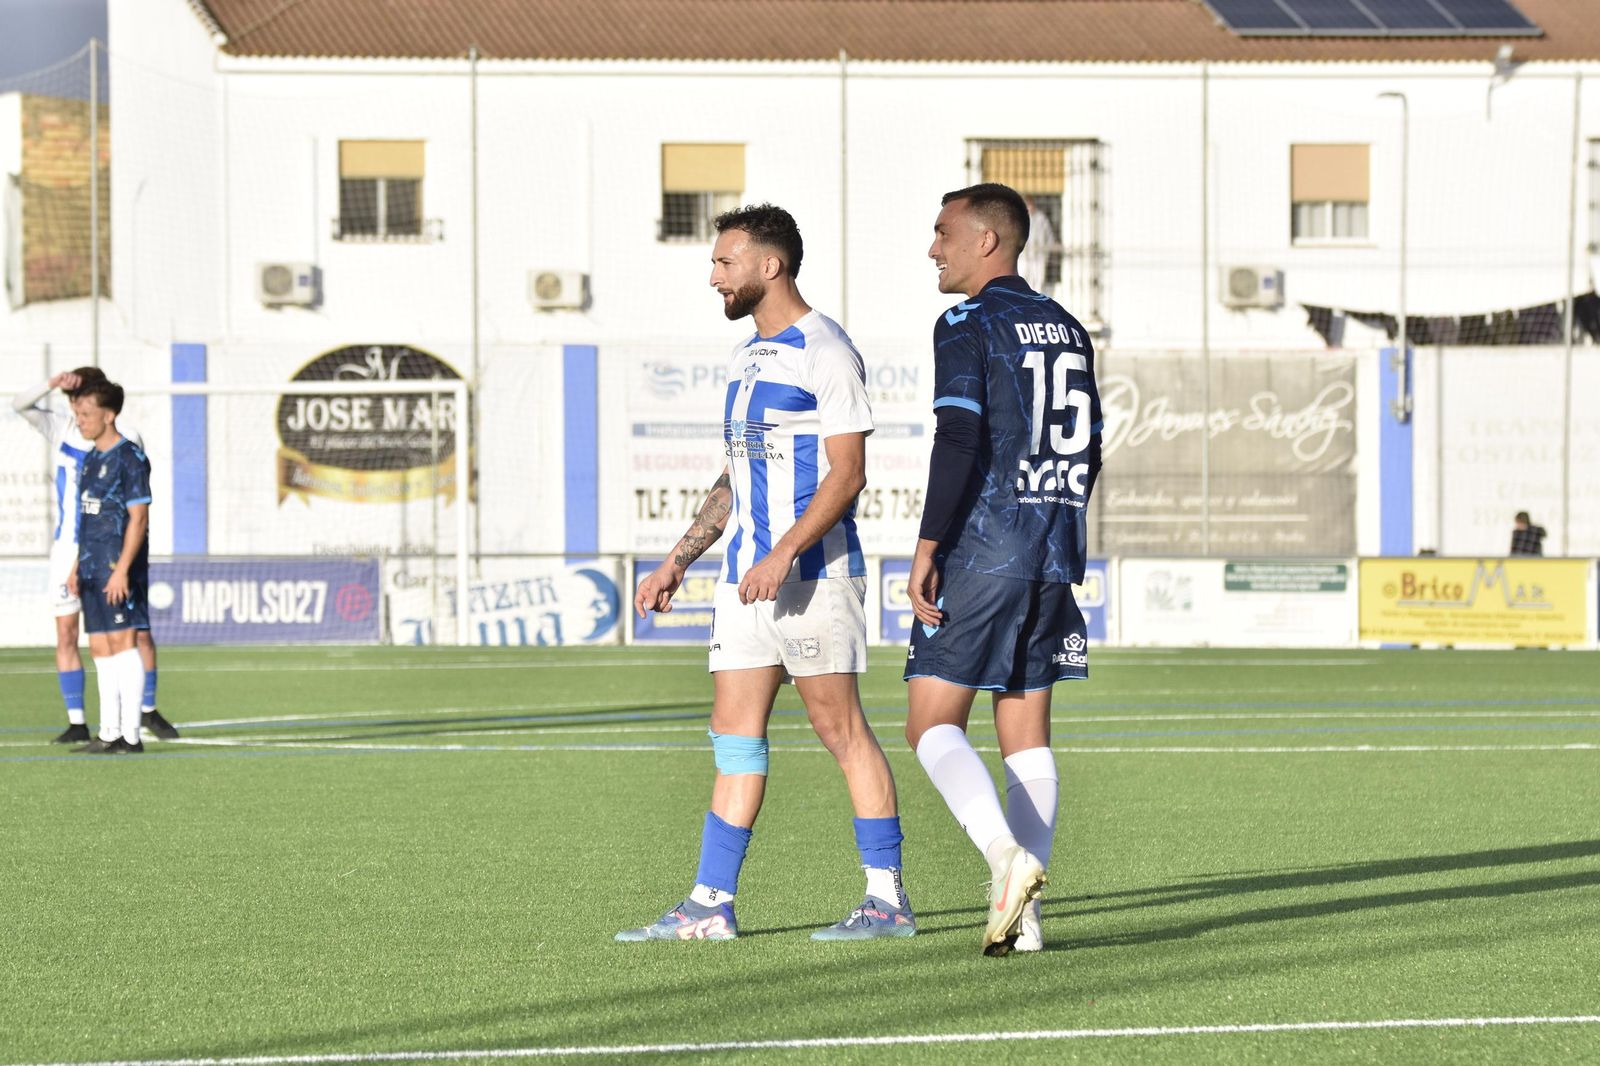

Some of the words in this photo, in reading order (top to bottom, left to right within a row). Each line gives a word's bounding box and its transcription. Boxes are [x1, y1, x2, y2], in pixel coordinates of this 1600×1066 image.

[1015, 322, 1070, 345] DIEGO
[287, 397, 373, 431] JOSE
[382, 397, 457, 431] MAR
[1021, 350, 1091, 456] 15
[1017, 496, 1042, 504] arbella
[1402, 572, 1463, 599] Brico
[182, 579, 328, 624] IMPULSO27
